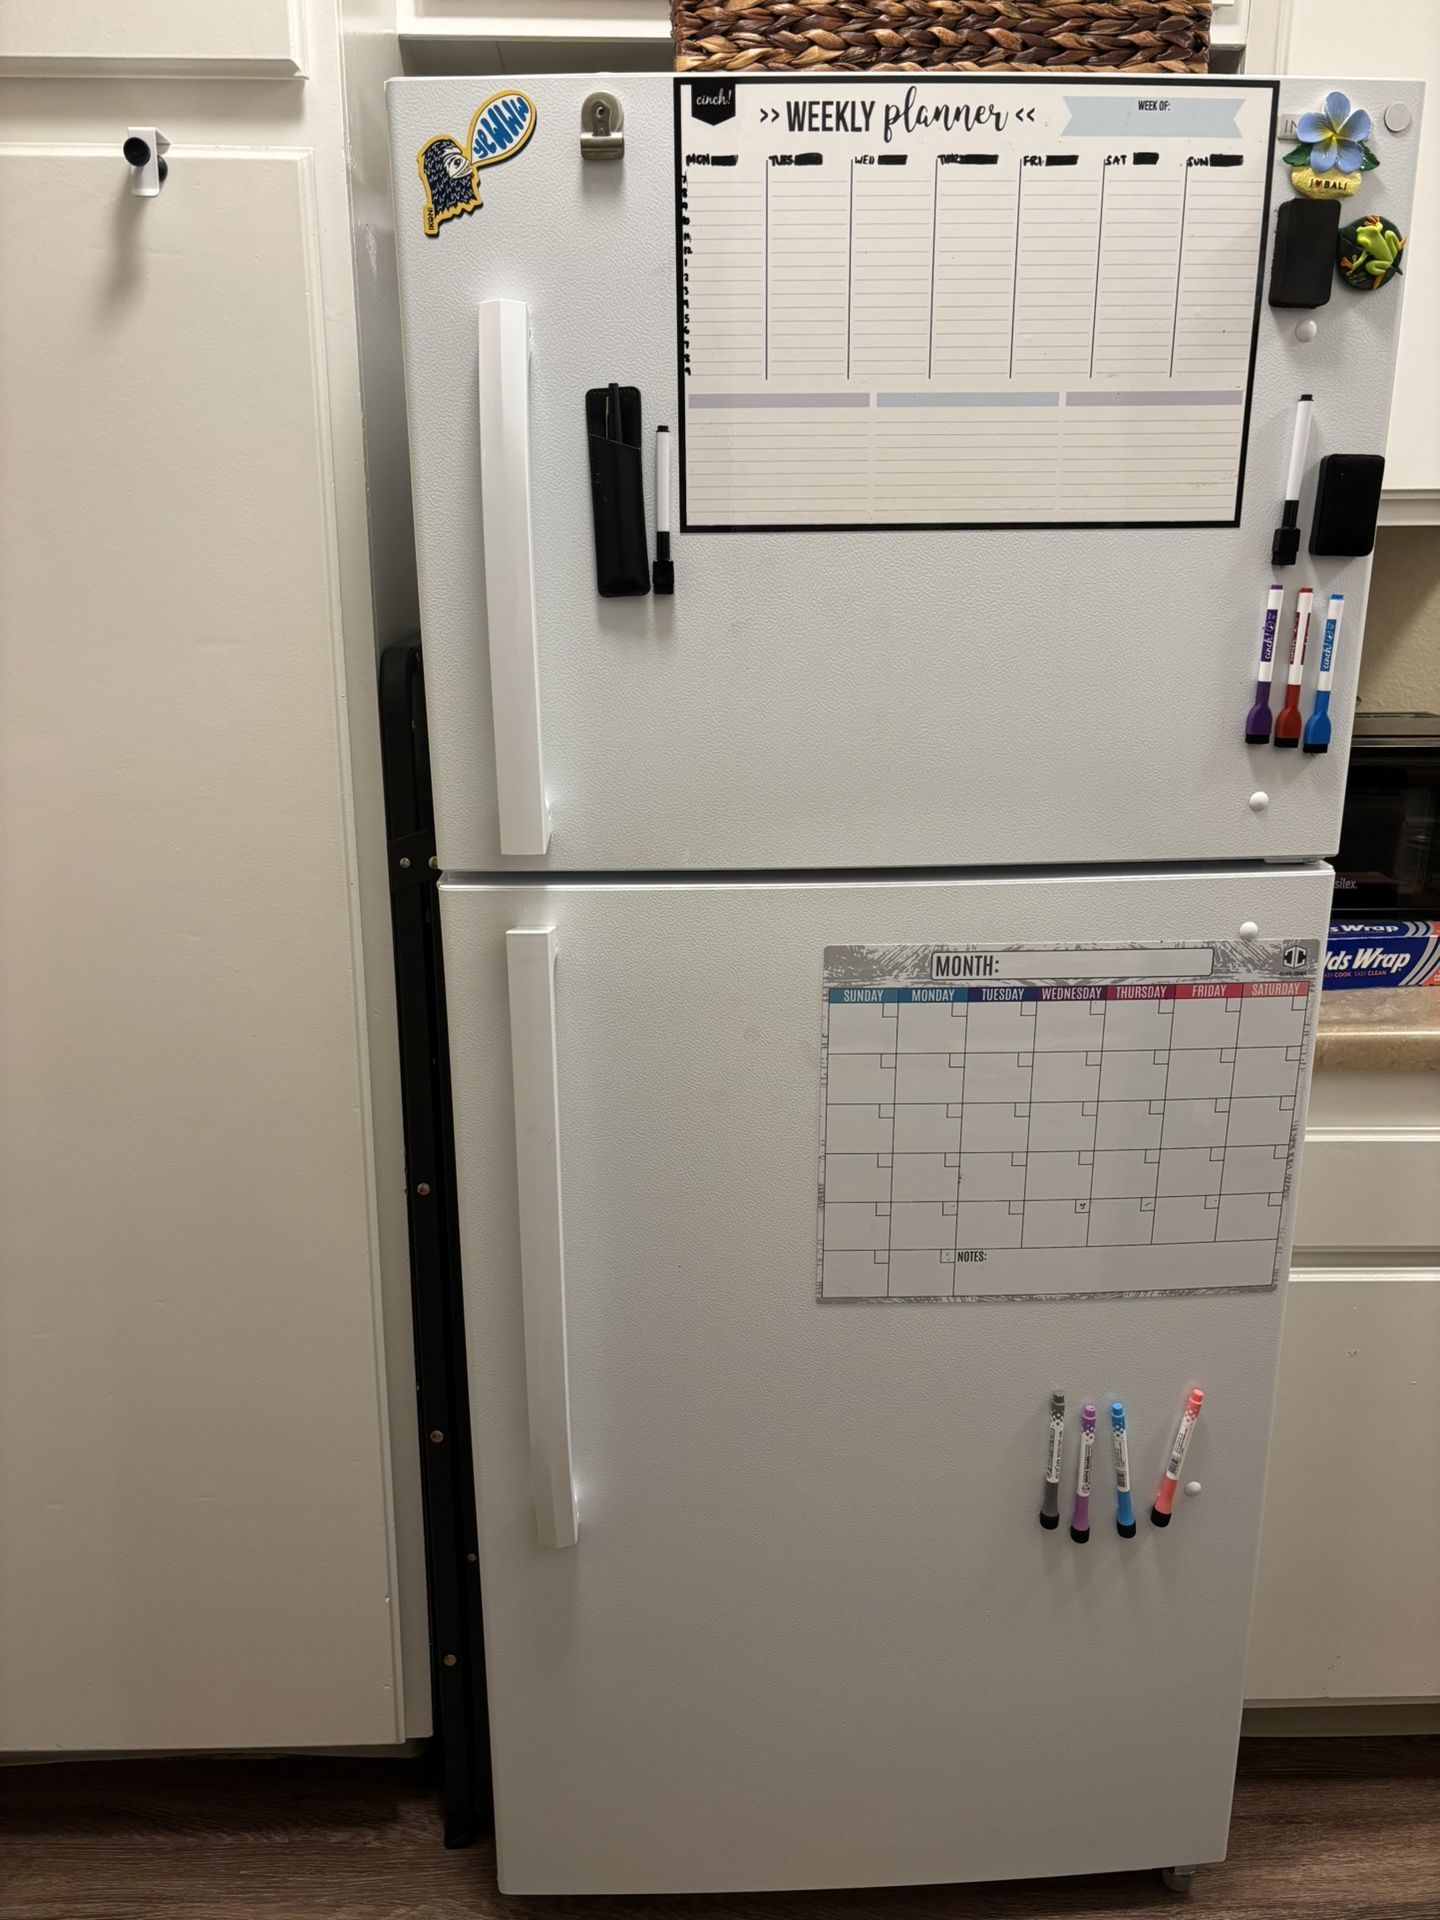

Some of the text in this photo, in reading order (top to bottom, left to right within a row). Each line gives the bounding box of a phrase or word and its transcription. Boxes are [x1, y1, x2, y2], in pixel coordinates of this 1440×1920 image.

[695, 87, 732, 106] cinch!
[1138, 100, 1171, 111] WEEK OF:
[786, 85, 1009, 144] WEEKLY planner
[685, 153, 710, 167] MON
[854, 155, 875, 165] WED
[1105, 155, 1127, 166] SAT
[1187, 156, 1209, 167] SUN
[1323, 180, 1348, 191] BALI
[684, 313, 690, 323] 5
[1340, 924, 1400, 933] Wrap
[935, 954, 1000, 977] MONTH:
[1352, 947, 1411, 974] Wrap
[843, 989, 884, 1002] SUNDAY
[911, 988, 955, 1002] MONDAY
[981, 987, 1025, 1001] TUESDAY
[1041, 987, 1102, 1000] WEDNESDAY
[1116, 985, 1167, 999] THURSDAY
[1192, 984, 1227, 997] FRIDAY
[1251, 982, 1301, 996] SATURDAY
[957, 1250, 988, 1263] NOTES:
